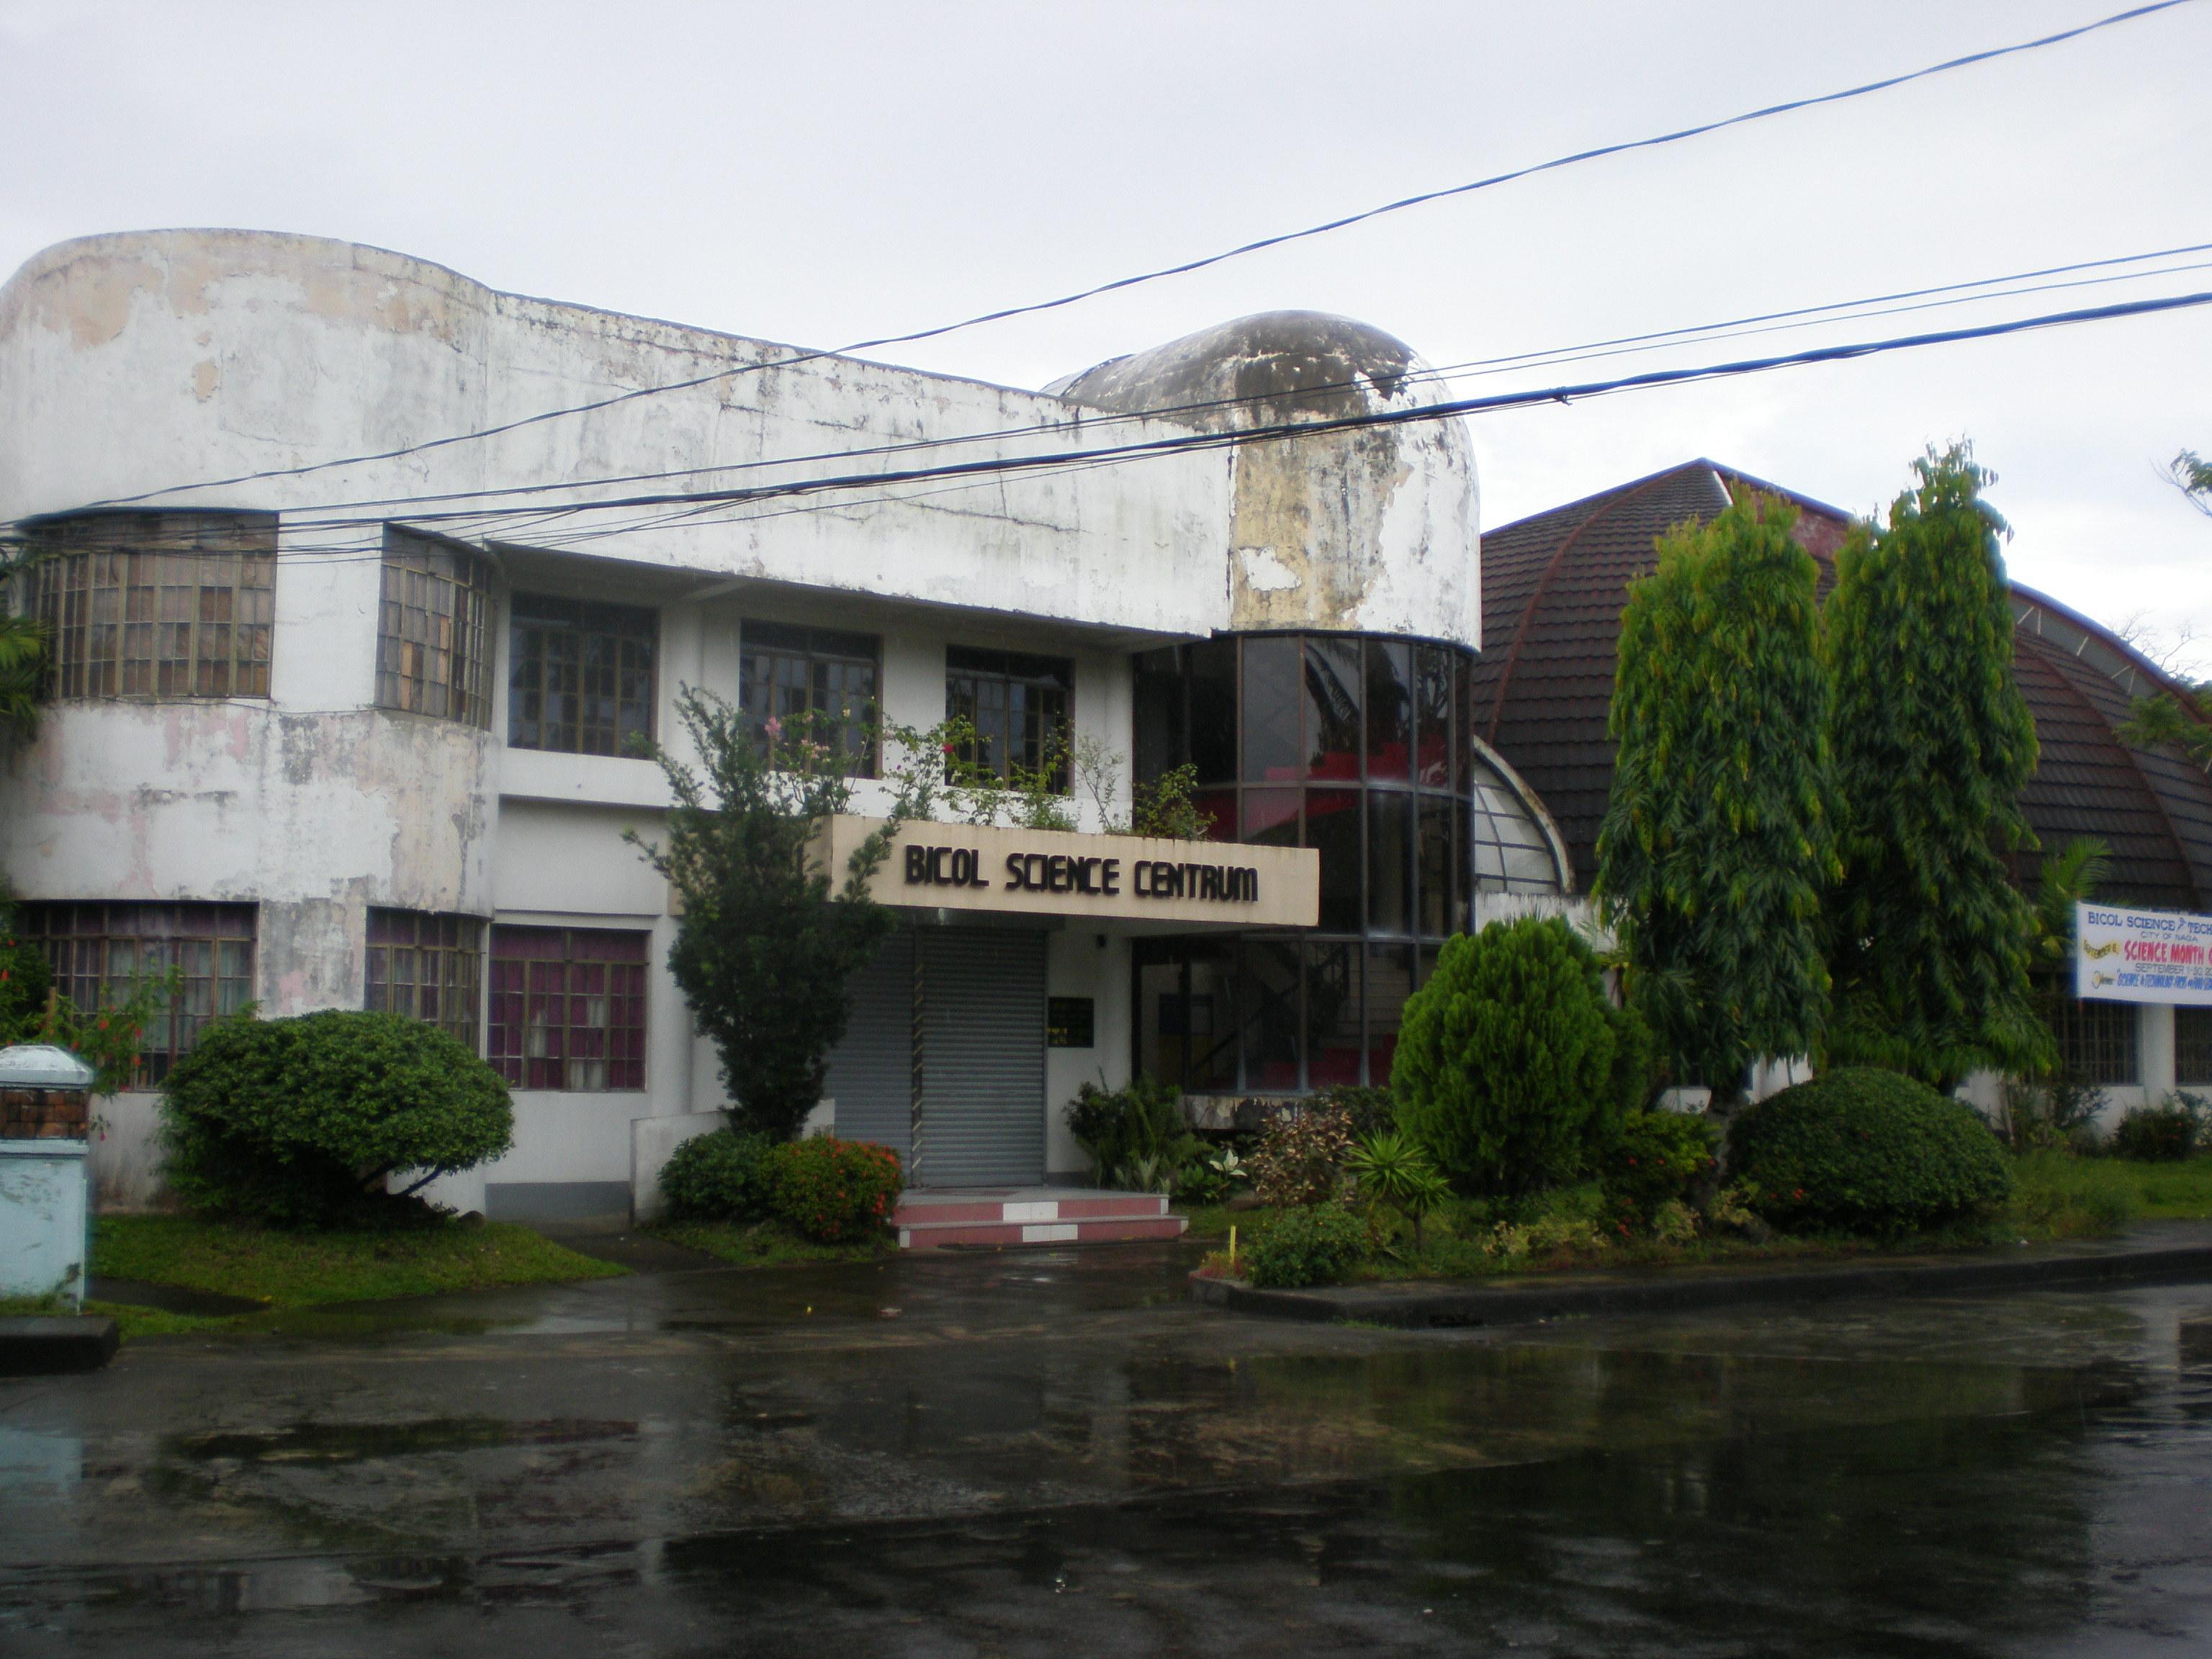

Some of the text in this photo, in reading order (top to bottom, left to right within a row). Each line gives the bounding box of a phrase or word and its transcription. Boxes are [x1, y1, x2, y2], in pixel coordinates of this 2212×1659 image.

[904, 844, 1259, 902] BICOL SCIENCE CENTRUM
[2088, 912, 2122, 927] BICOL
[2127, 916, 2175, 931] SCIENCE
[2141, 931, 2160, 940] CITY
[2124, 939, 2167, 963] SCIENCE
[2170, 943, 2204, 966] MONTH
[2135, 963, 2184, 974] SEPTEMBER
